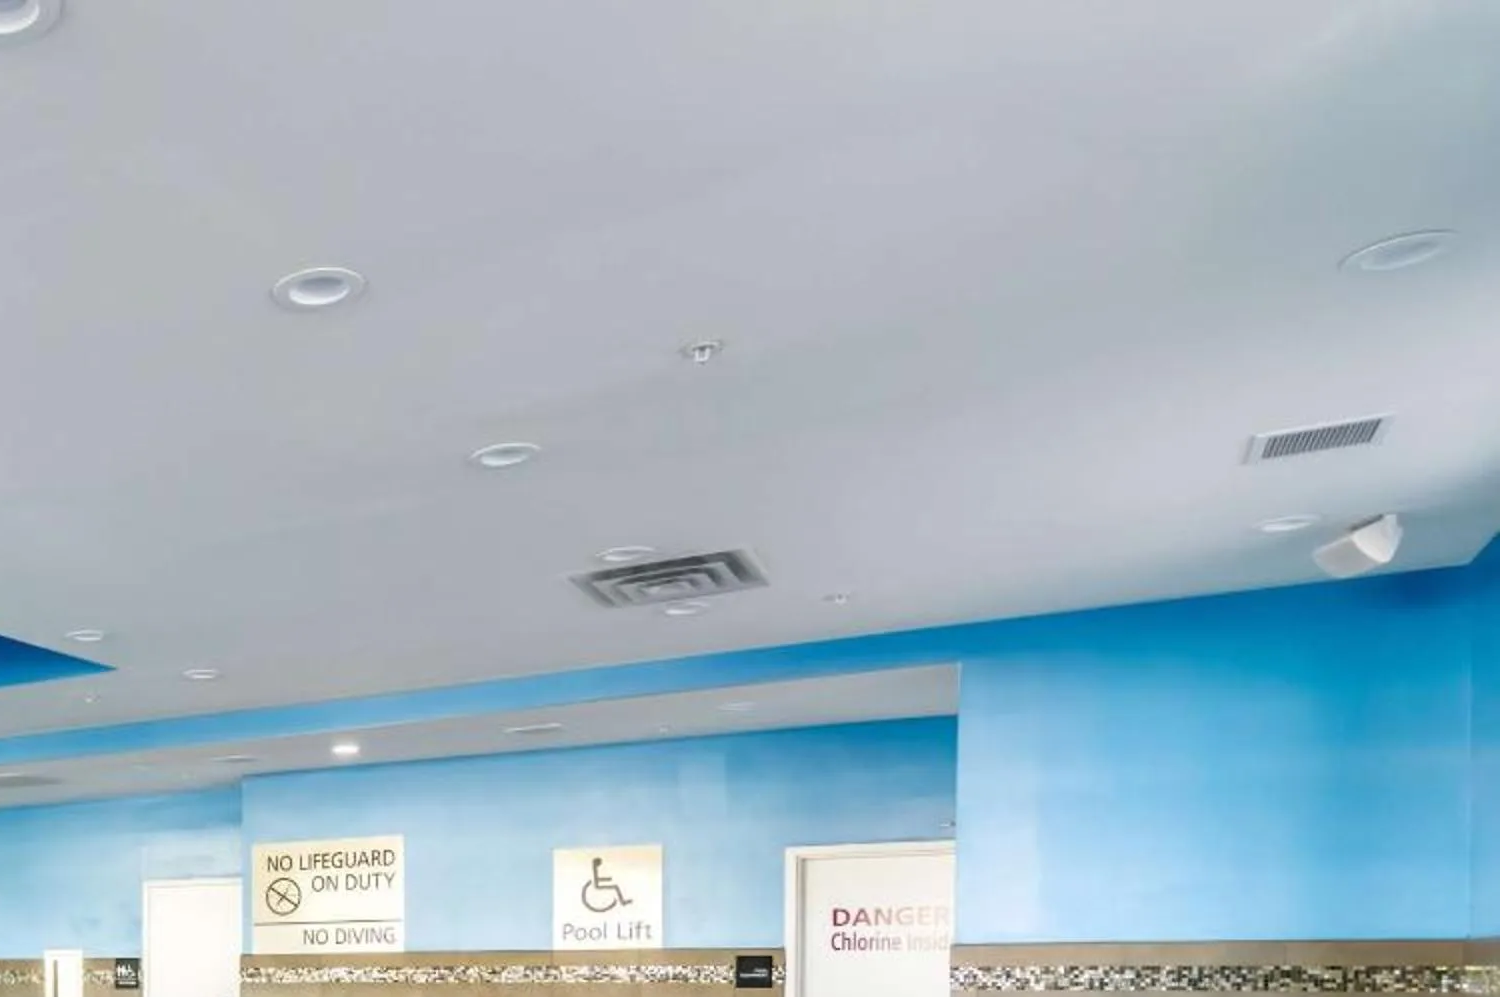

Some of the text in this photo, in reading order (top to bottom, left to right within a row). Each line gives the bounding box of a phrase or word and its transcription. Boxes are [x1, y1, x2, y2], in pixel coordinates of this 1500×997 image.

[266, 849, 396, 872] NO LIFEGUARD
[311, 872, 396, 892] ON DUTY
[832, 906, 950, 927] DANGER
[303, 927, 396, 945] NO DIVING
[562, 920, 652, 941] Pool Lift
[831, 931, 949, 951] Chlorine Insid
